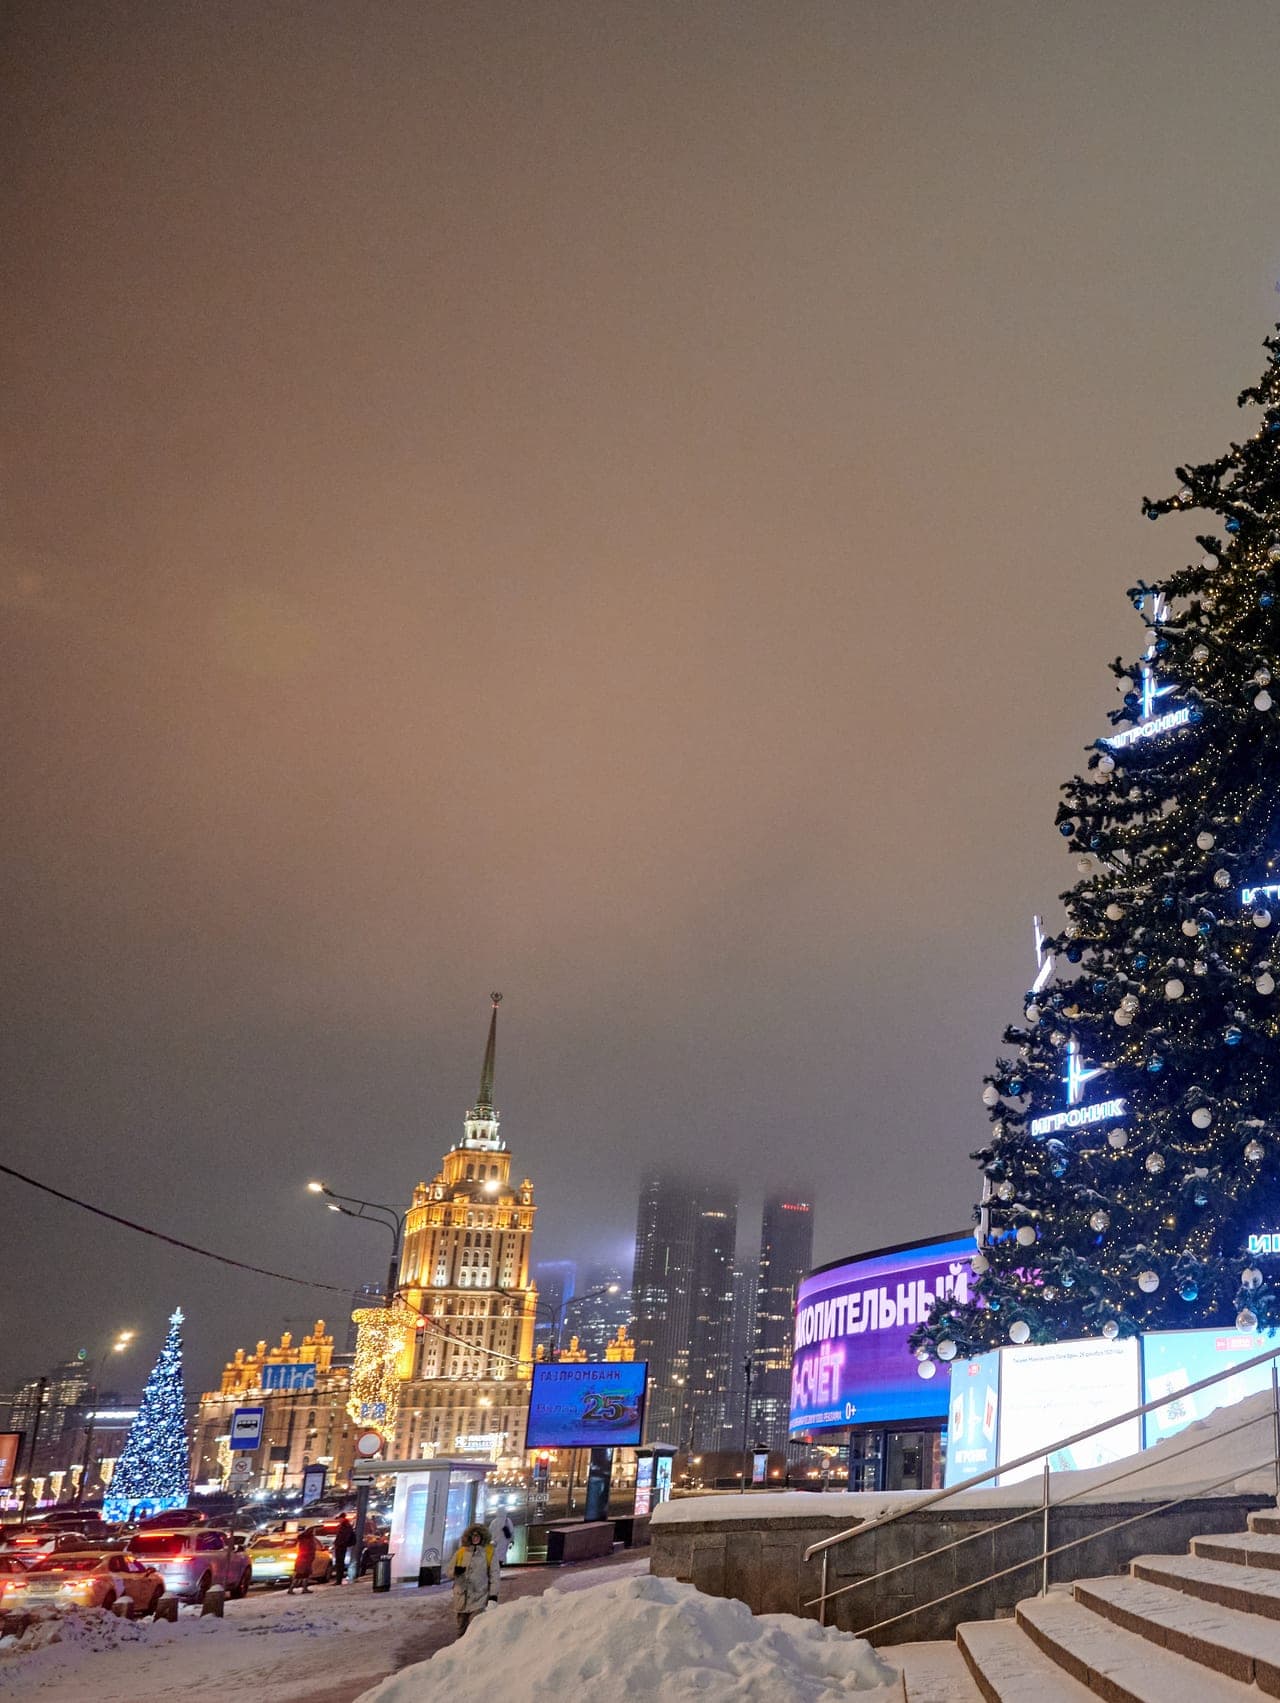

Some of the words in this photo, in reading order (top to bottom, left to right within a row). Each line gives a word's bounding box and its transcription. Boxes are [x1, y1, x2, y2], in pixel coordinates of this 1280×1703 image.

[1032, 1098, 1127, 1136] ИГРОНИК
[582, 1394, 625, 1420] 25
[846, 1402, 856, 1419] 0+
